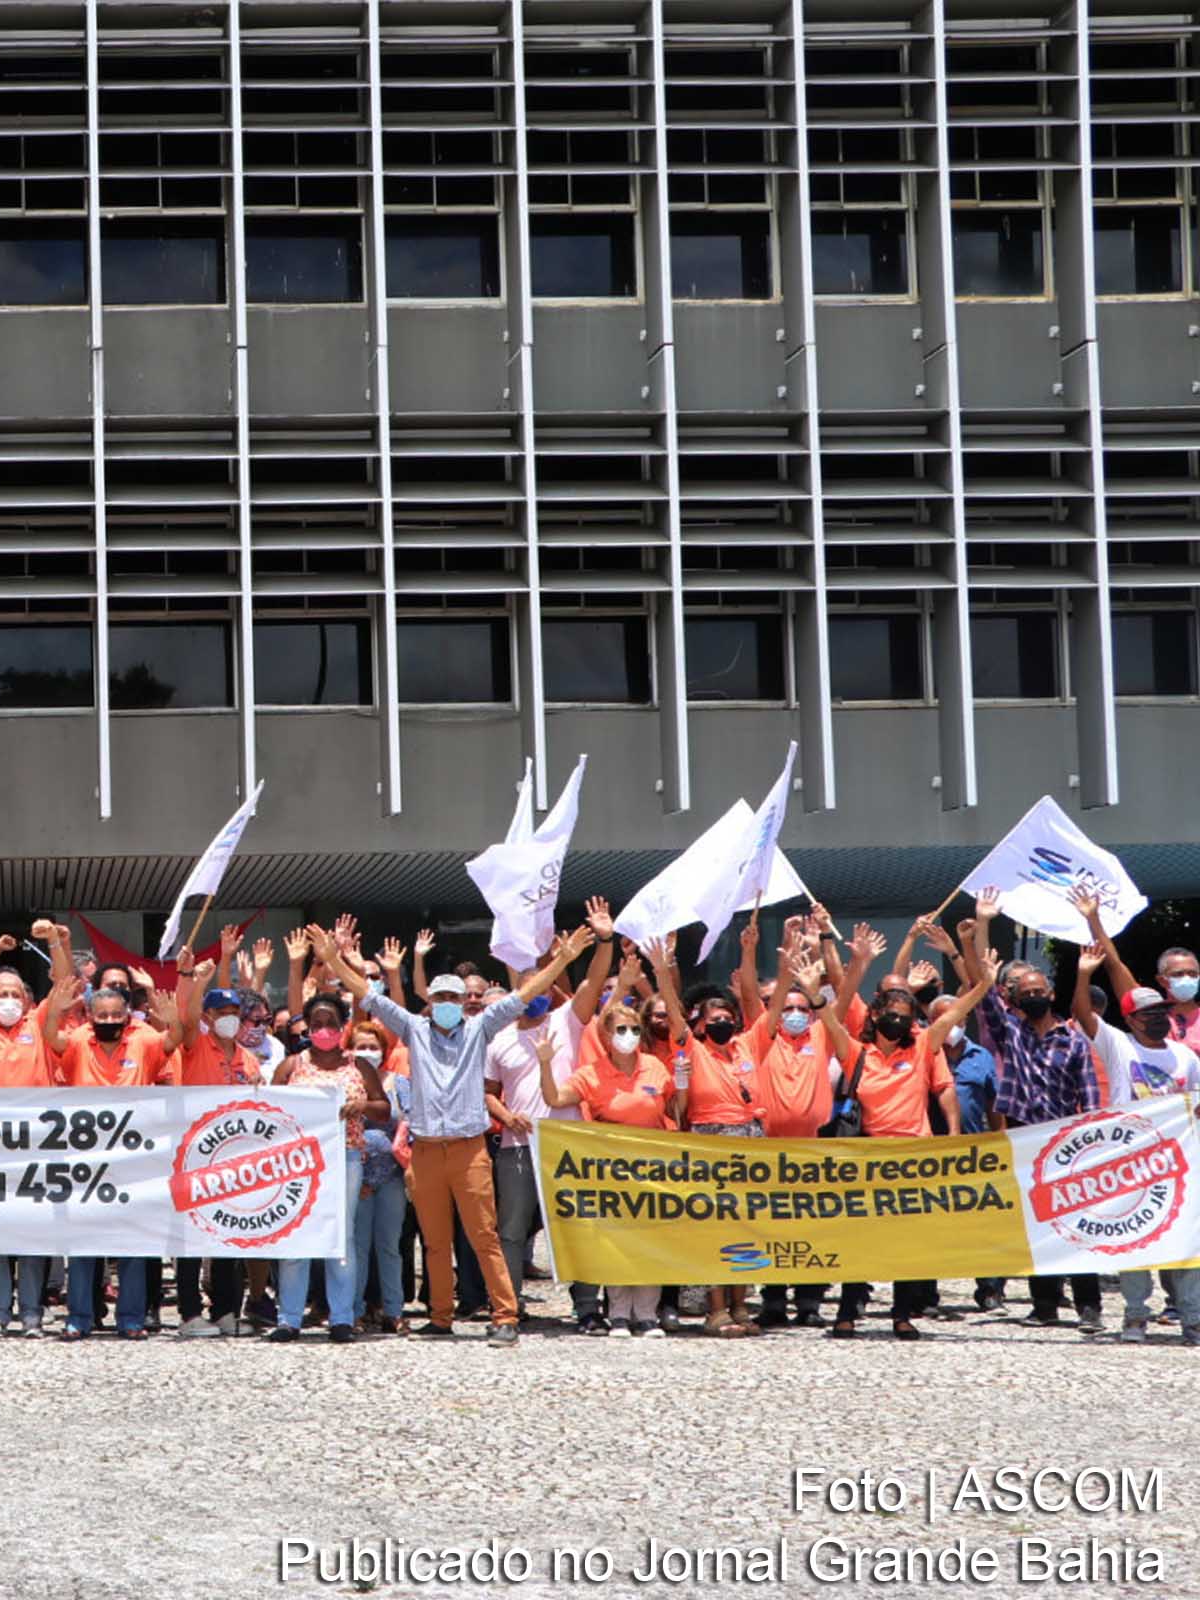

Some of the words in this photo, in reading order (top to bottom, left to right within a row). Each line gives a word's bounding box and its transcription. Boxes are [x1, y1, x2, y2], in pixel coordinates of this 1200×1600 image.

[39, 1110, 155, 1151] 28%.
[198, 1119, 247, 1155] CHEGA
[254, 1119, 277, 1140] DE
[1055, 1128, 1105, 1166] CHEGA
[1111, 1127, 1134, 1144] DE
[16, 1162, 130, 1204] 45%.
[191, 1145, 316, 1202] ARROCHO!
[554, 1150, 770, 1189] Arrecadação
[778, 1152, 858, 1184] bate
[866, 1146, 1008, 1182] recorde.
[1051, 1147, 1179, 1212] ARROCHO!
[212, 1203, 288, 1230] REPOSIÇÃO
[286, 1182, 303, 1206] JÁ!
[554, 1189, 740, 1220] SERVIDOR
[746, 1190, 867, 1220] PERDE
[876, 1182, 1014, 1216] RENDA.
[1078, 1208, 1154, 1237] REPOSIÇÃO
[1151, 1185, 1167, 1209] JÁ!
